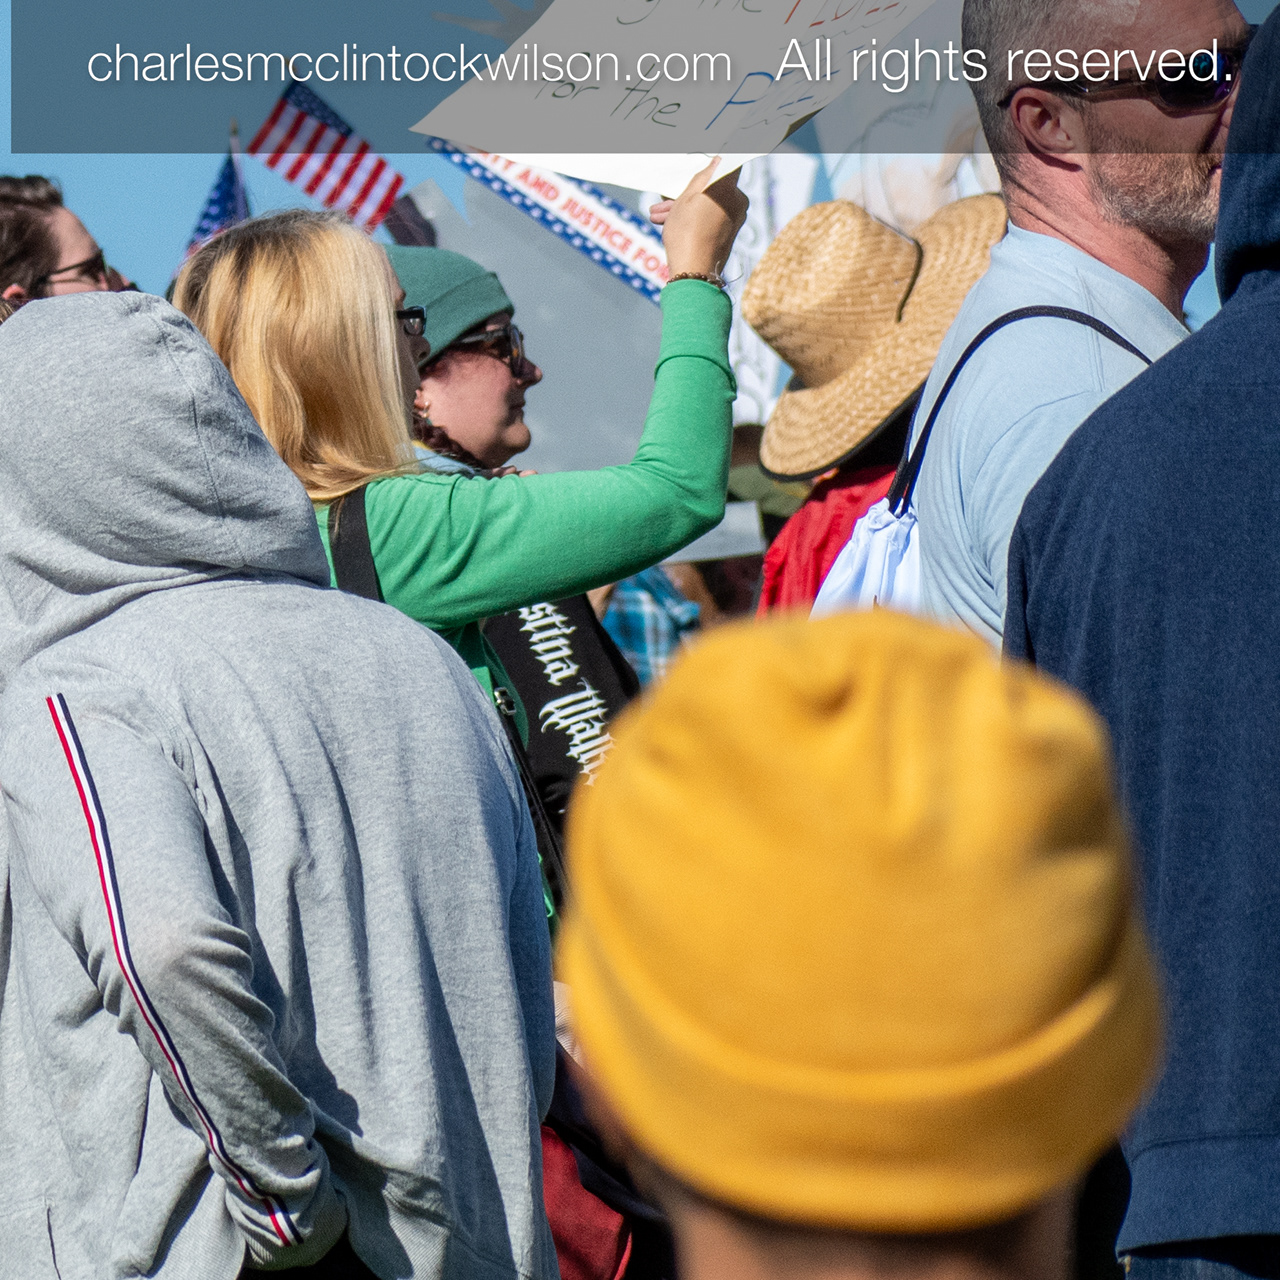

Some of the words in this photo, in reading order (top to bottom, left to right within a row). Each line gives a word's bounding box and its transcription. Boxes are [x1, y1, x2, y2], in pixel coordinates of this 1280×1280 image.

[517, 168, 559, 201] AND
[561, 196, 633, 255] JUSTICE
[517, 601, 581, 687] stina
